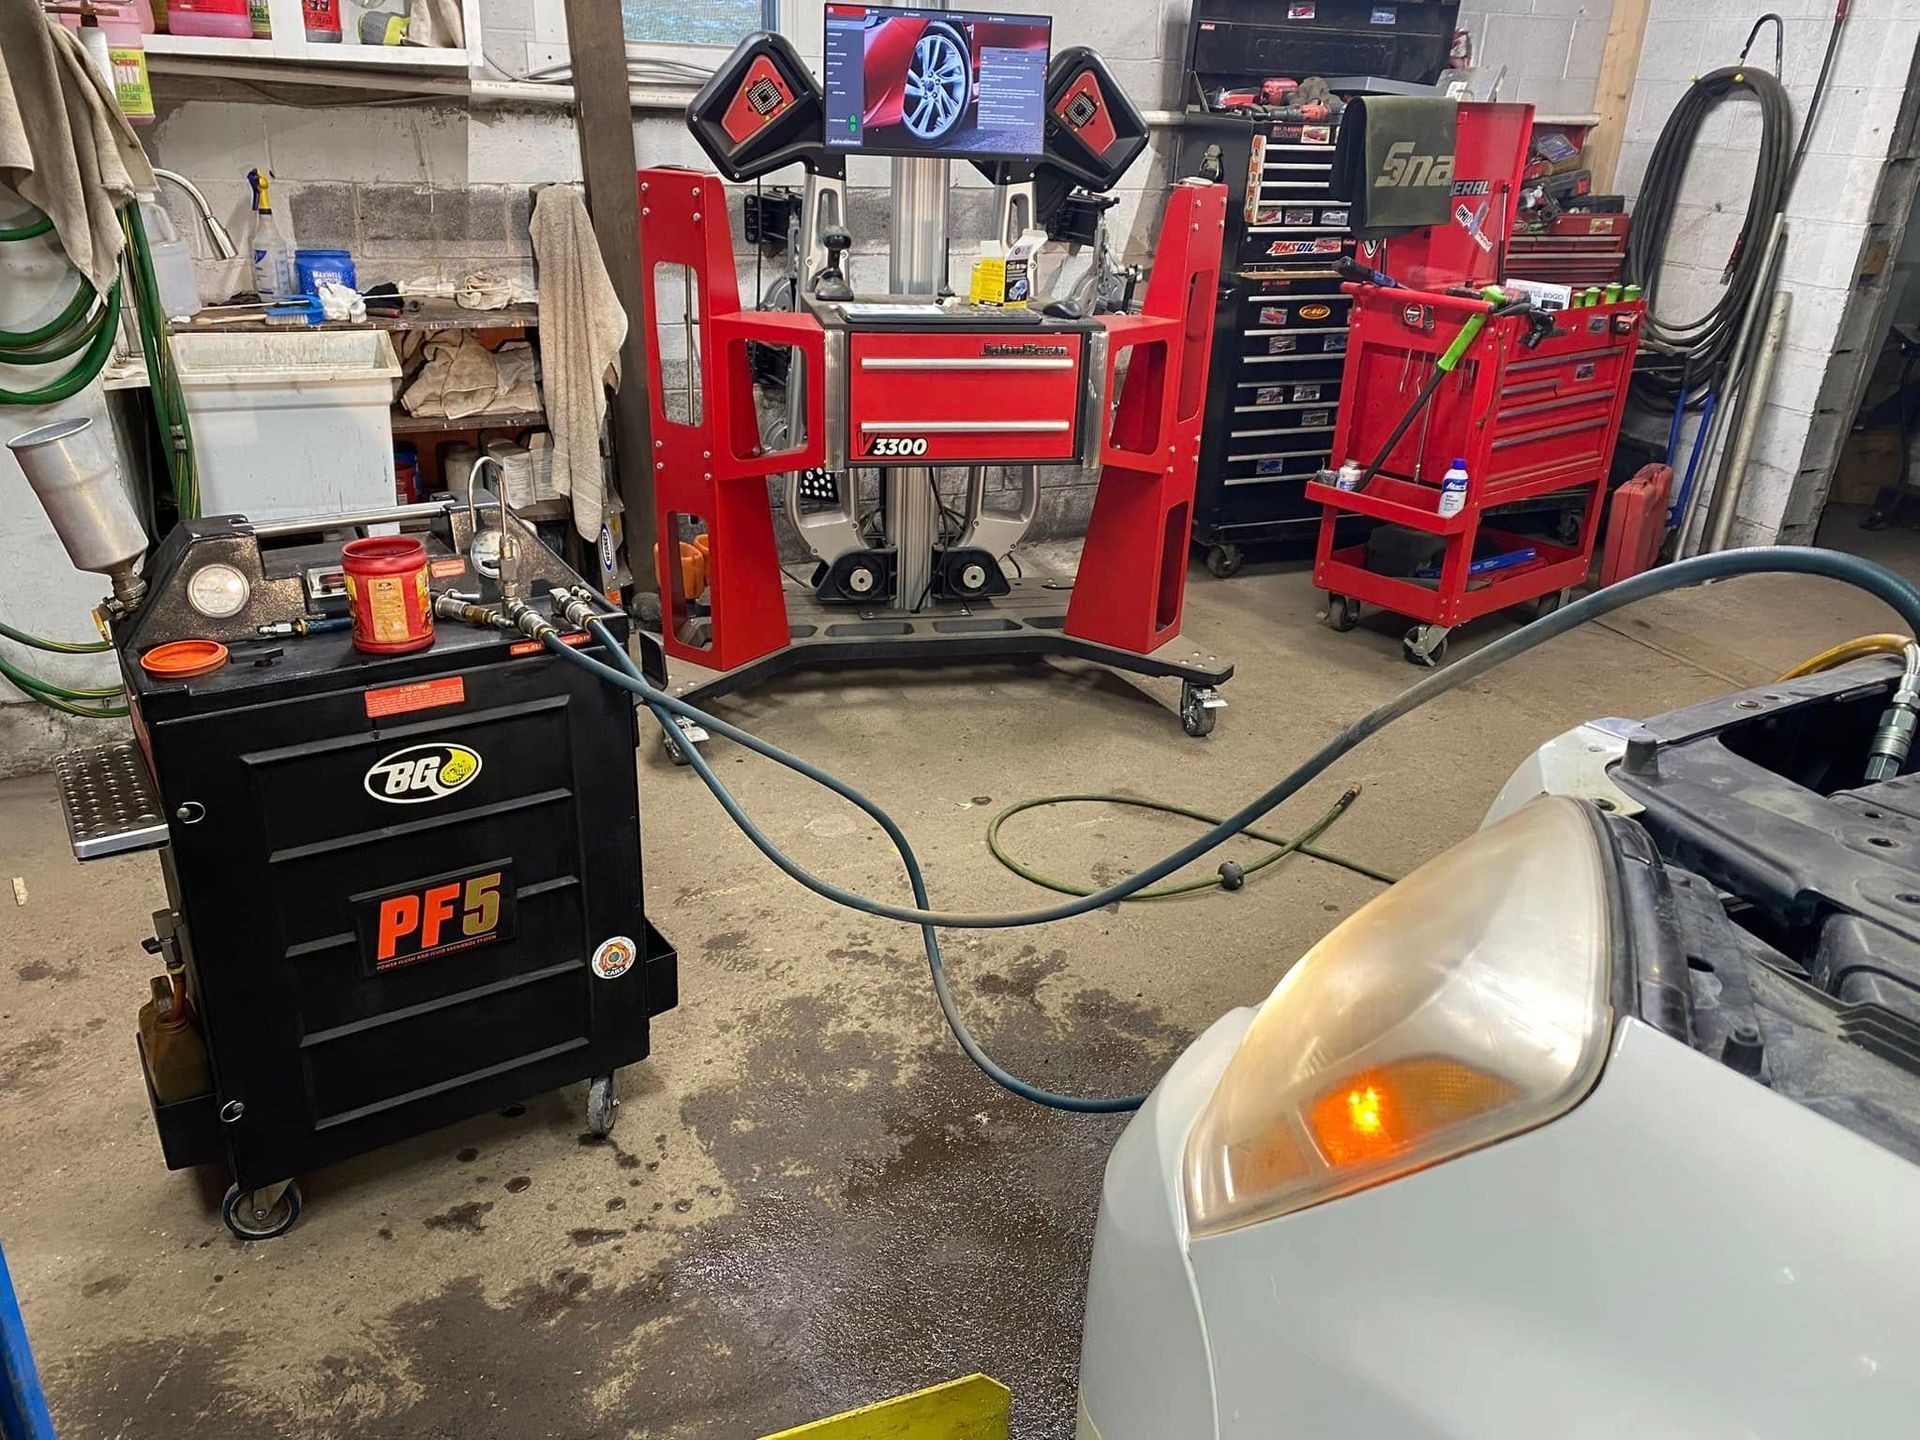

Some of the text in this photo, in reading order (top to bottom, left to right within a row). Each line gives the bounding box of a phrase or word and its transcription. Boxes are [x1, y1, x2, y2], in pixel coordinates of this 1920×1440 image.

[1450, 180, 1490, 196] ERAL
[1269, 241, 1316, 255] AMSOIL
[602, 530, 612, 562] WERNER
[385, 755, 441, 795] BG
[376, 961, 398, 971] POWER
[416, 951, 430, 961] AND
[476, 934, 497, 944] SYSTEM
[605, 966, 626, 977] CARE
